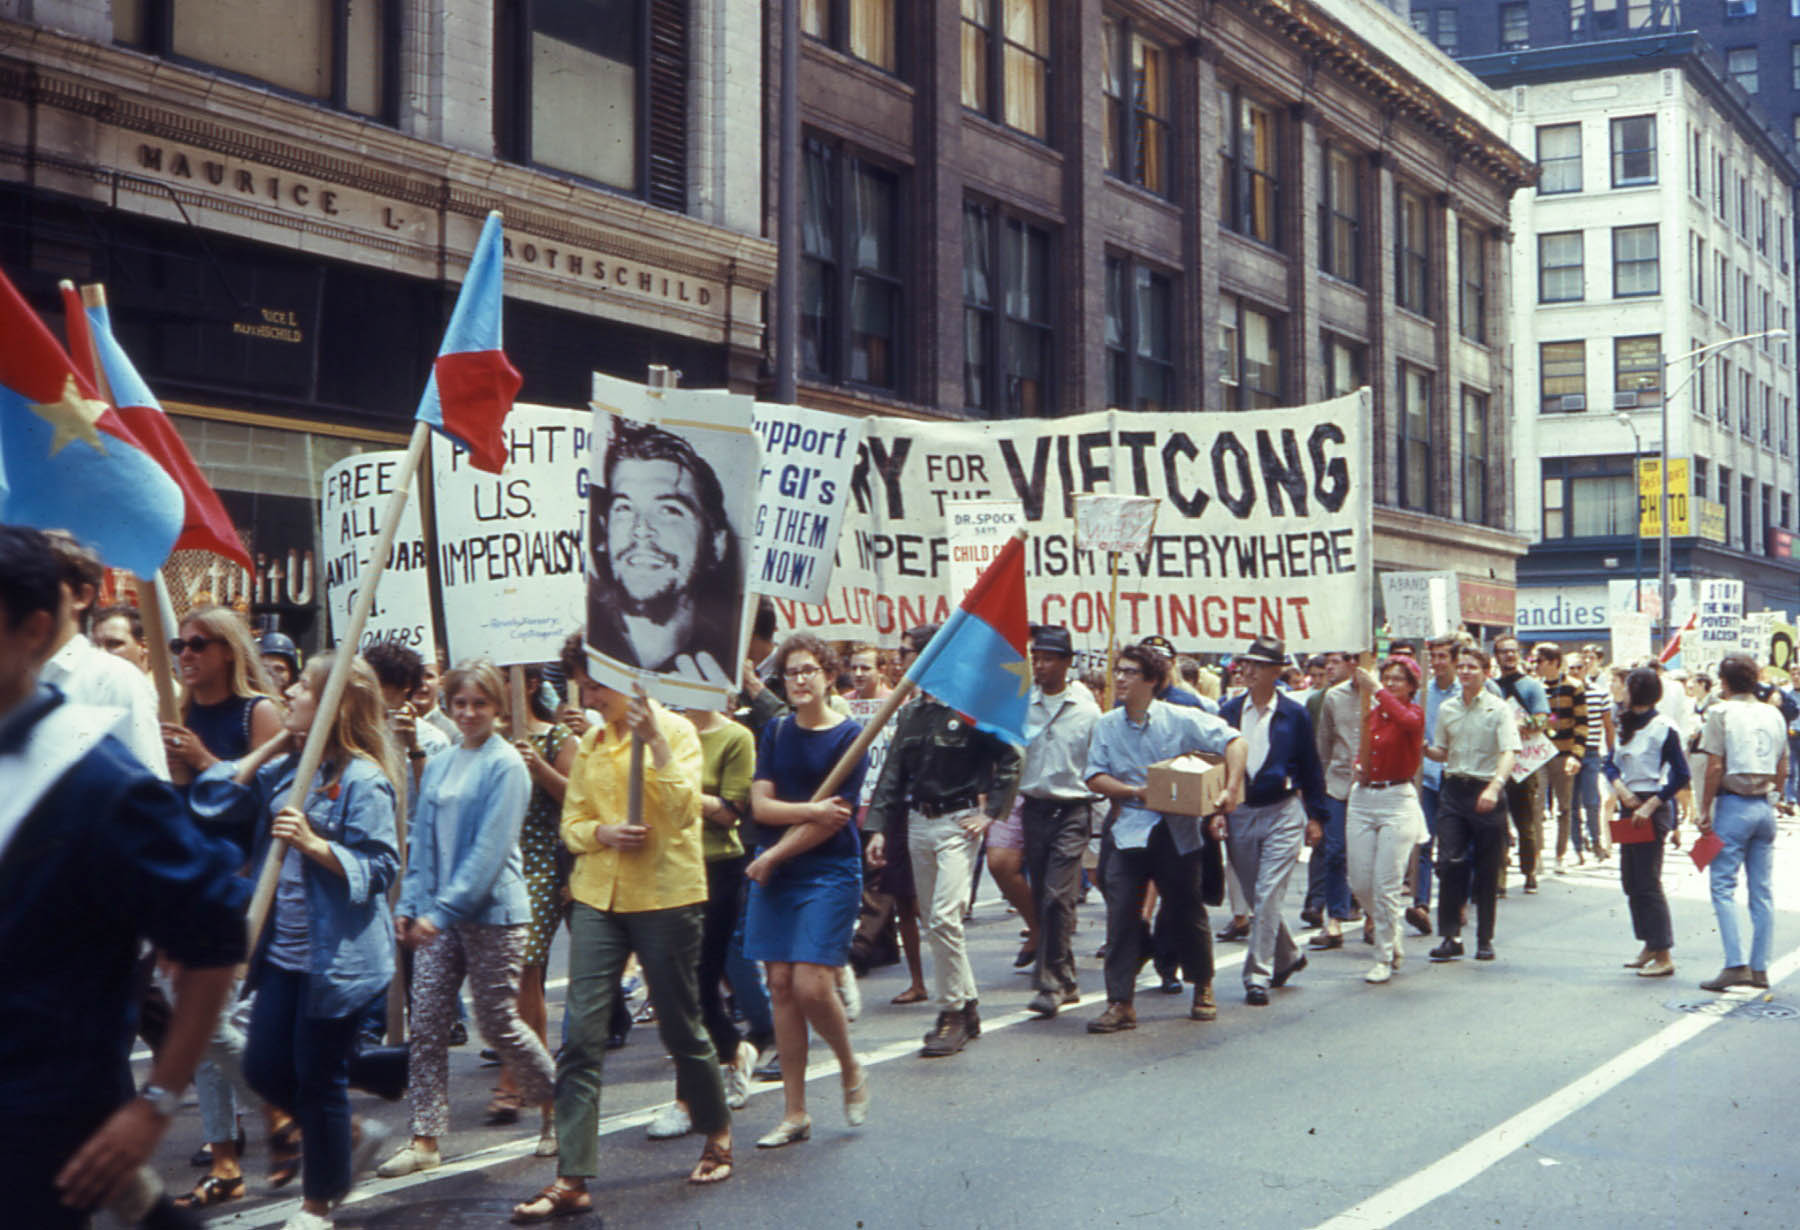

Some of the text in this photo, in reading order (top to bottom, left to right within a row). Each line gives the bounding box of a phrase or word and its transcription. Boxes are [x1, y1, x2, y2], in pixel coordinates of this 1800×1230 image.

[138, 143, 339, 216] MAURICE
[503, 237, 712, 306] ROTHSCHILD
[328, 462, 396, 511] FREE
[925, 454, 989, 482] FOR
[998, 422, 1350, 522] VIETCONG
[474, 479, 537, 521] U.S.
[1639, 493, 1685, 523] PHTO
[341, 506, 381, 545] ALL
[773, 506, 829, 550] THEM
[761, 547, 816, 591] NOW!
[953, 545, 989, 562] CHILD
[1107, 528, 1356, 579] EVERYWHERE
[1041, 592, 1310, 640] CONTINGENT
[1517, 595, 1606, 626] andies
